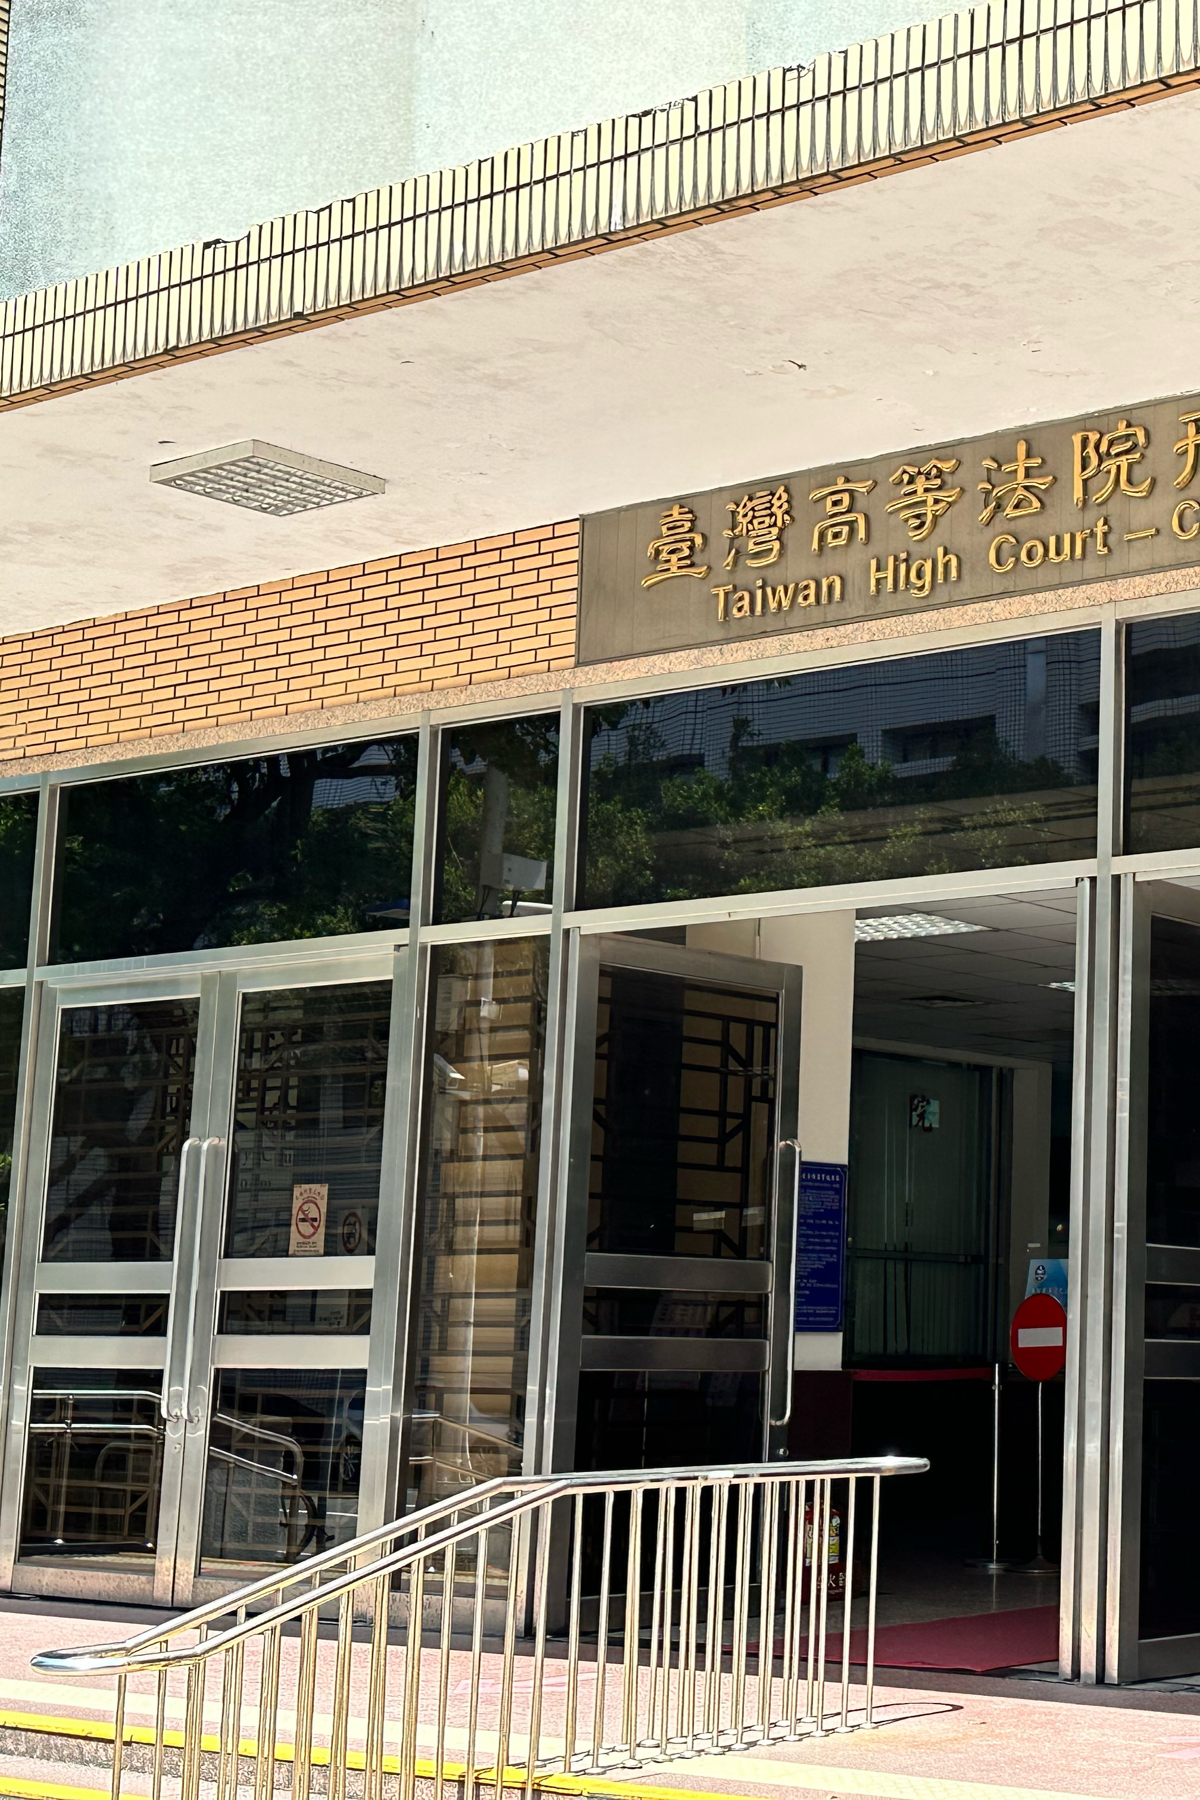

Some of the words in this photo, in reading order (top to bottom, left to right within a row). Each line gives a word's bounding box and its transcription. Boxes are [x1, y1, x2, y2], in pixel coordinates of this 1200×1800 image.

[711, 573, 843, 622] Taiwan
[870, 545, 959, 598] High
[988, 515, 1111, 574] Court
